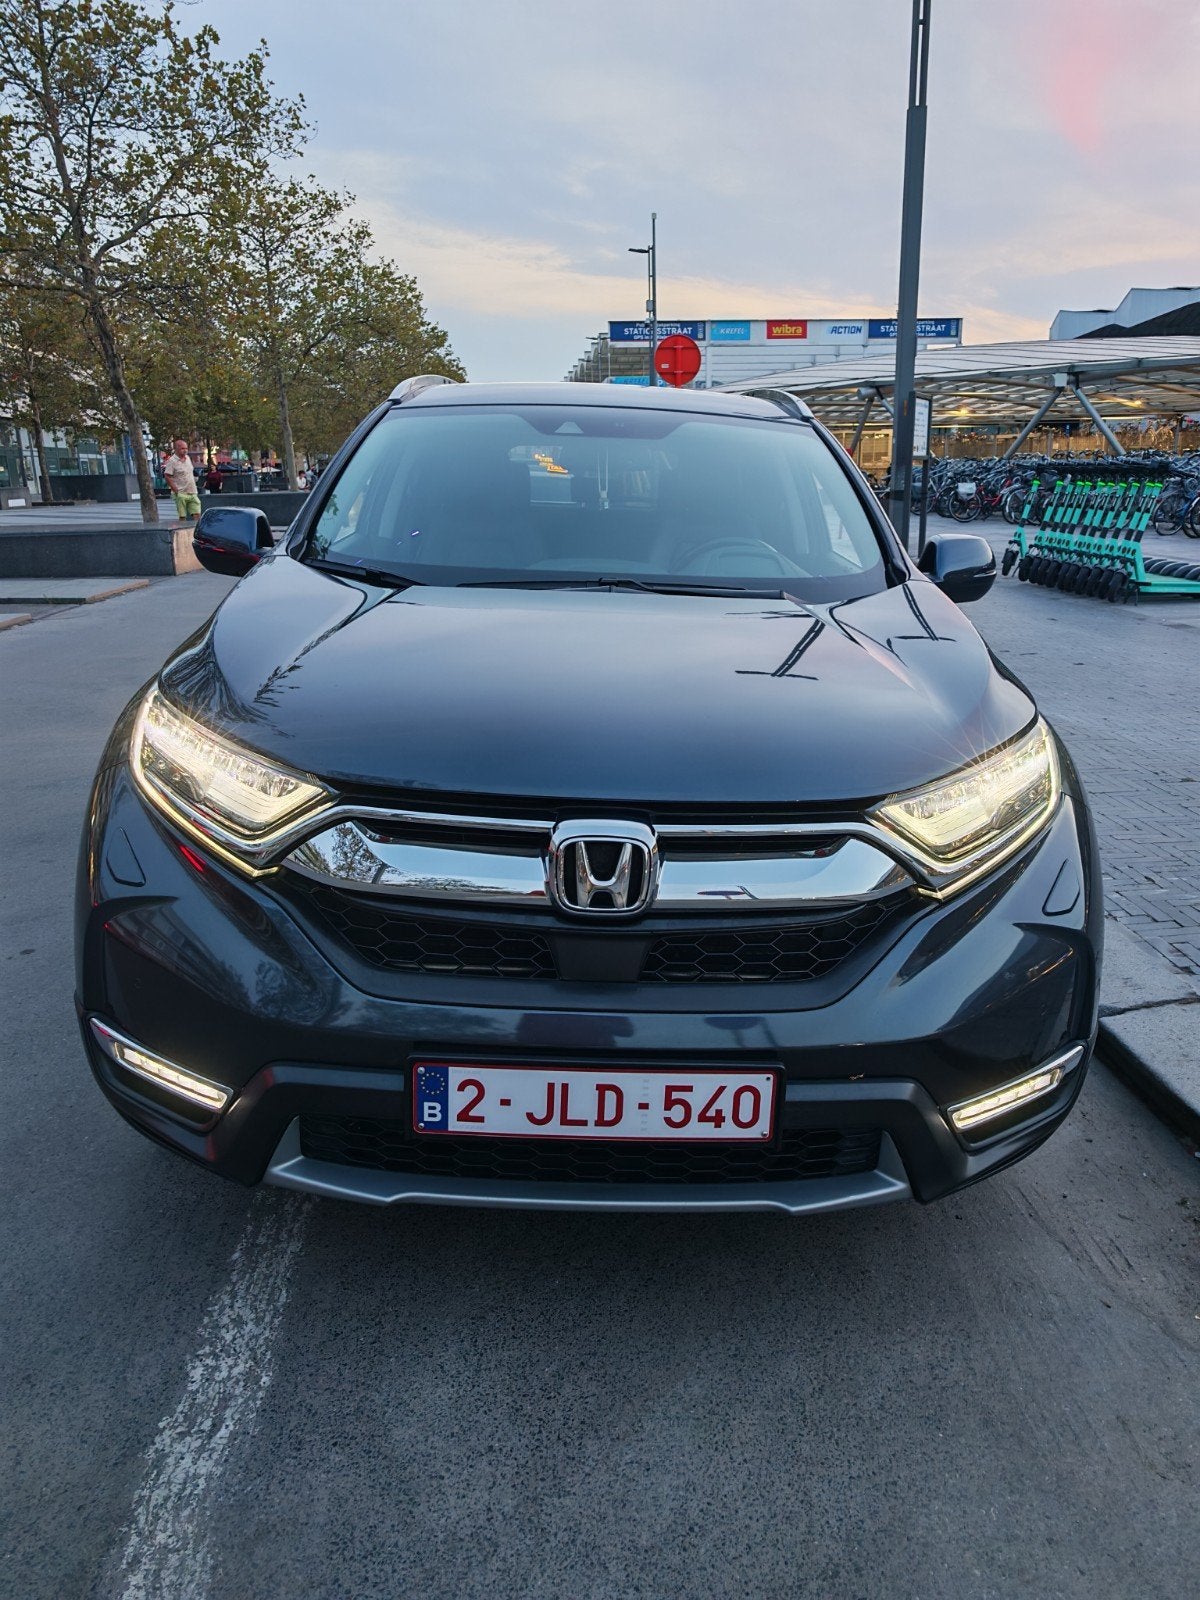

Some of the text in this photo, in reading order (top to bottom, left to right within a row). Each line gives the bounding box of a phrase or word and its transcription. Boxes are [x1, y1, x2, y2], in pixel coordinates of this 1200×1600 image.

[772, 325, 802, 334] wibra
[830, 325, 862, 334] ACTION
[880, 324, 946, 332] STATSTRAAT
[423, 1078, 762, 1130] B 2-JLD-540
